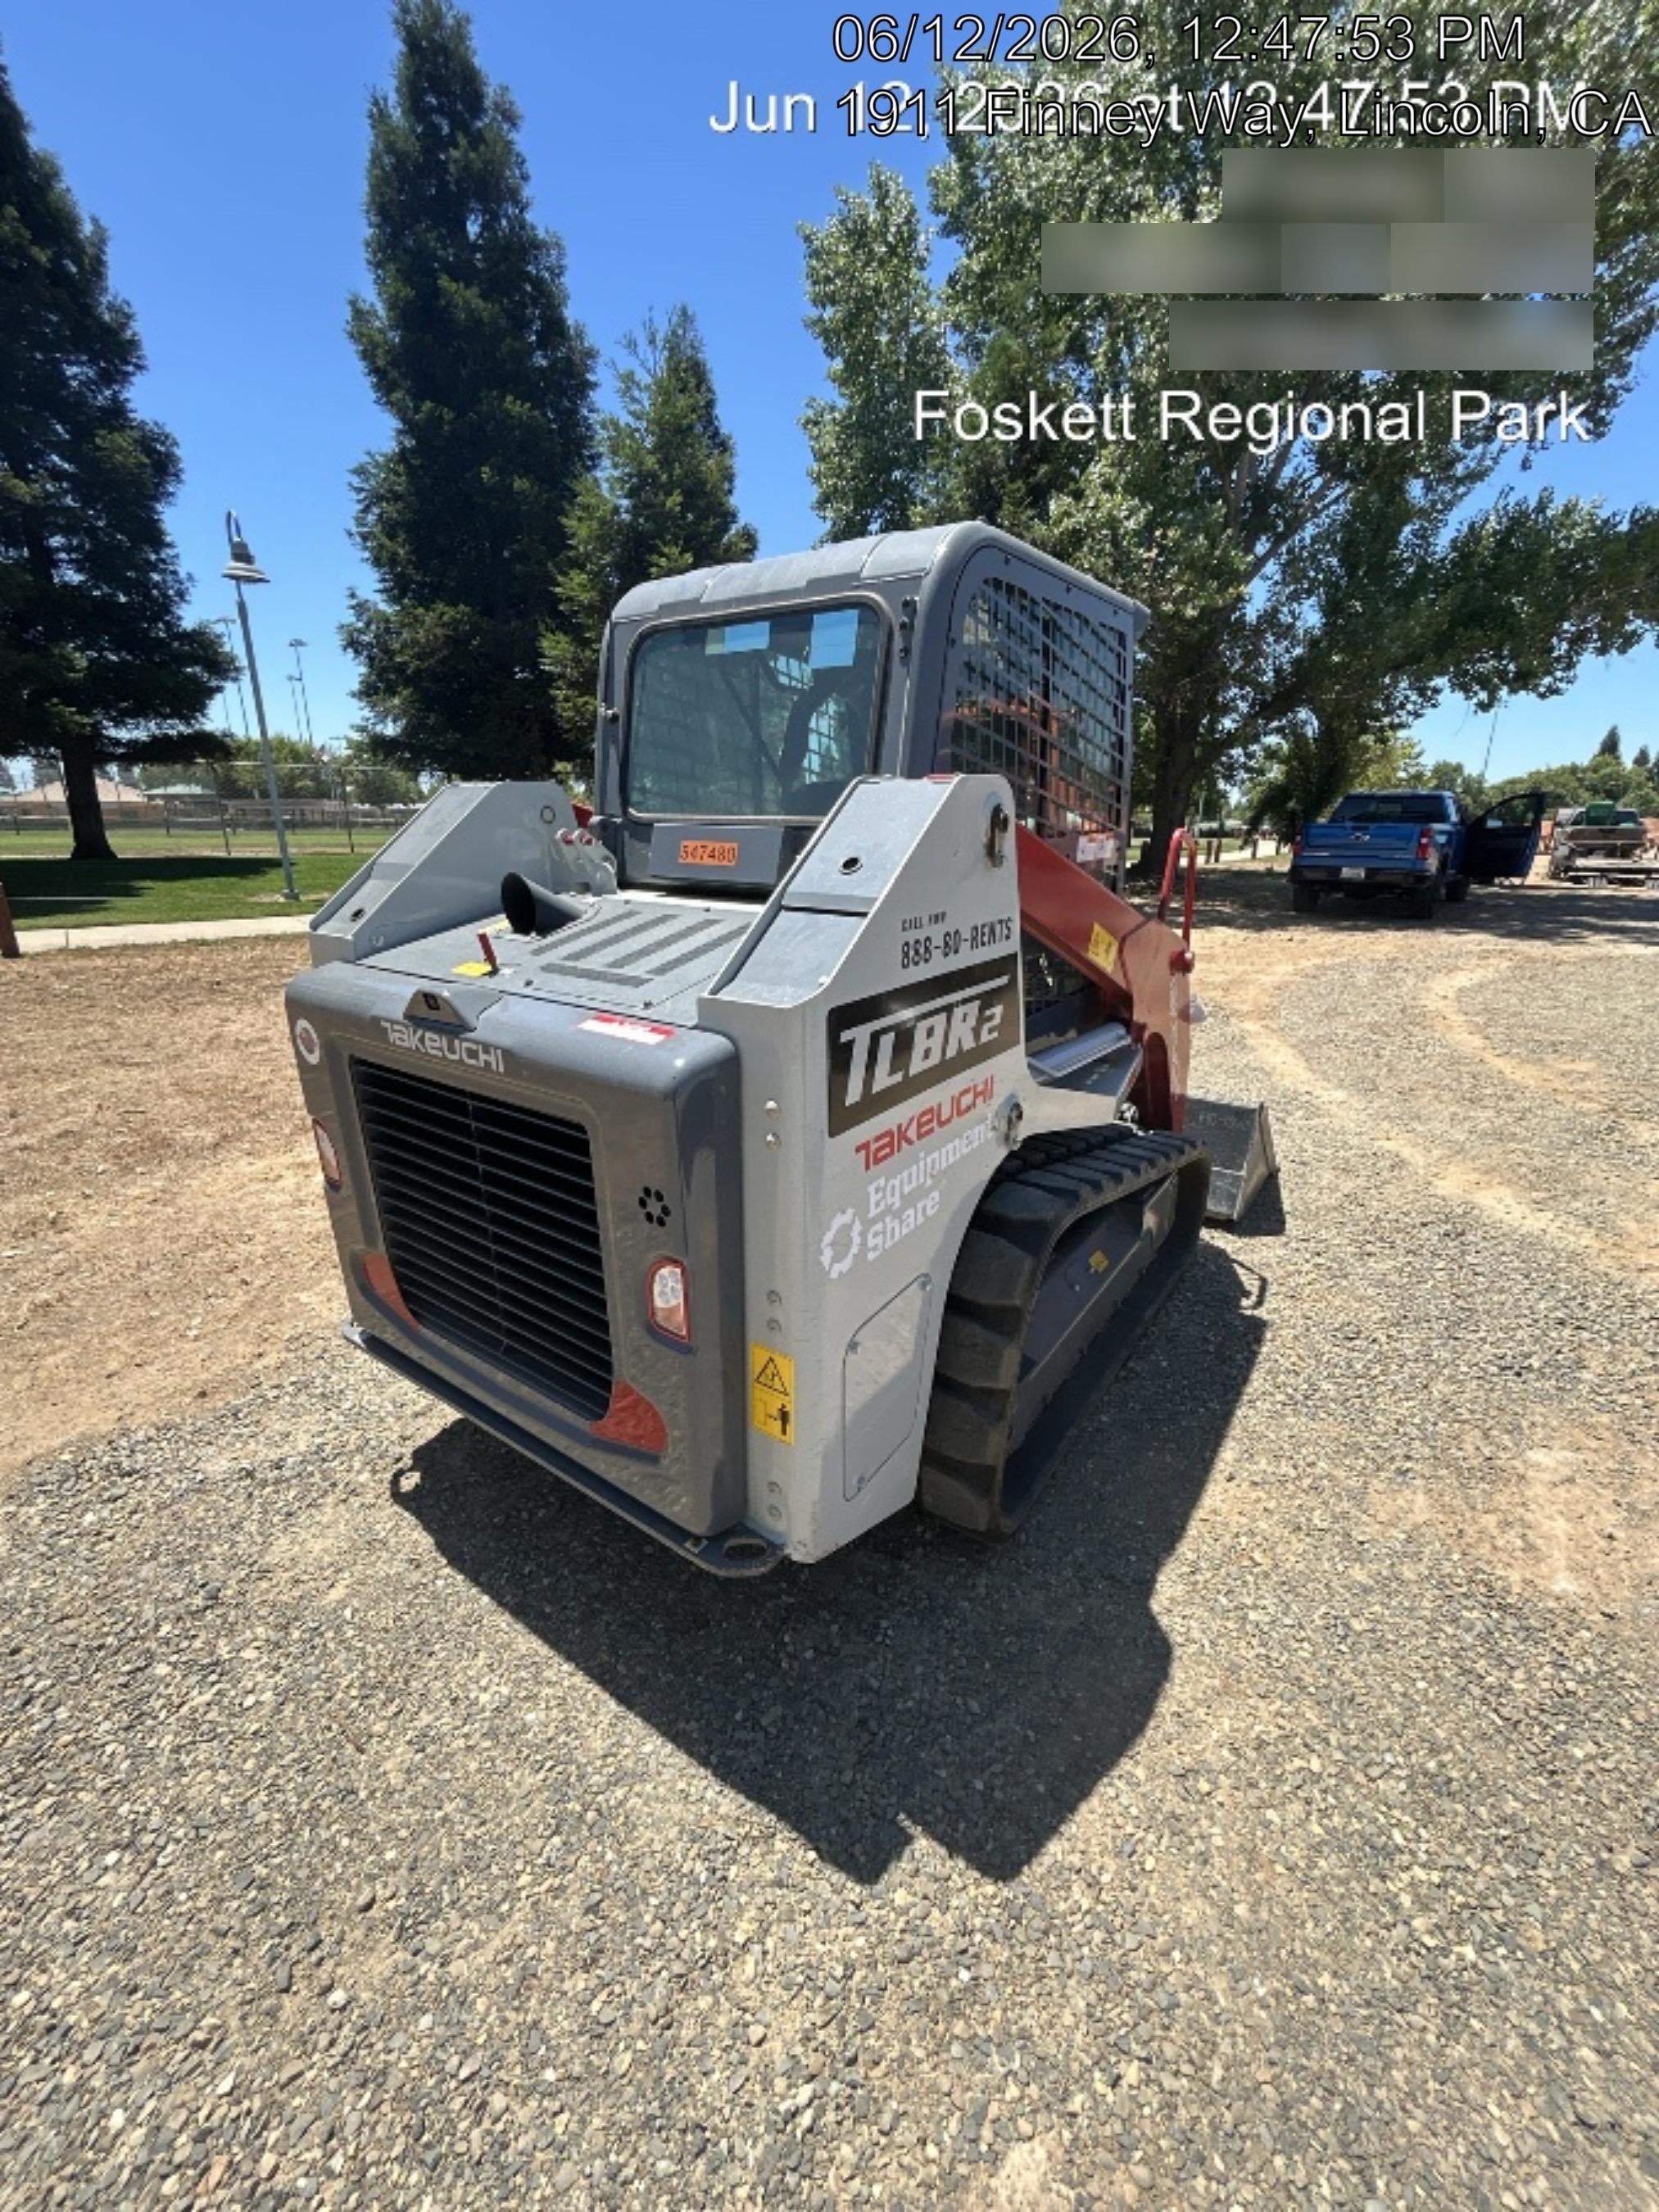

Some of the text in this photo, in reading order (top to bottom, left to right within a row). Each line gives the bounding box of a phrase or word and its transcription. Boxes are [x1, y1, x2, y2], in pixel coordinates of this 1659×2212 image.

[901, 916, 1013, 969] 888-80-RENTS
[380, 1019, 505, 1074] TAKEUCHI
[855, 1074, 994, 1173] TAKEUCHI
[867, 1113, 994, 1220] Equipment
[864, 1189, 941, 1262] Share
